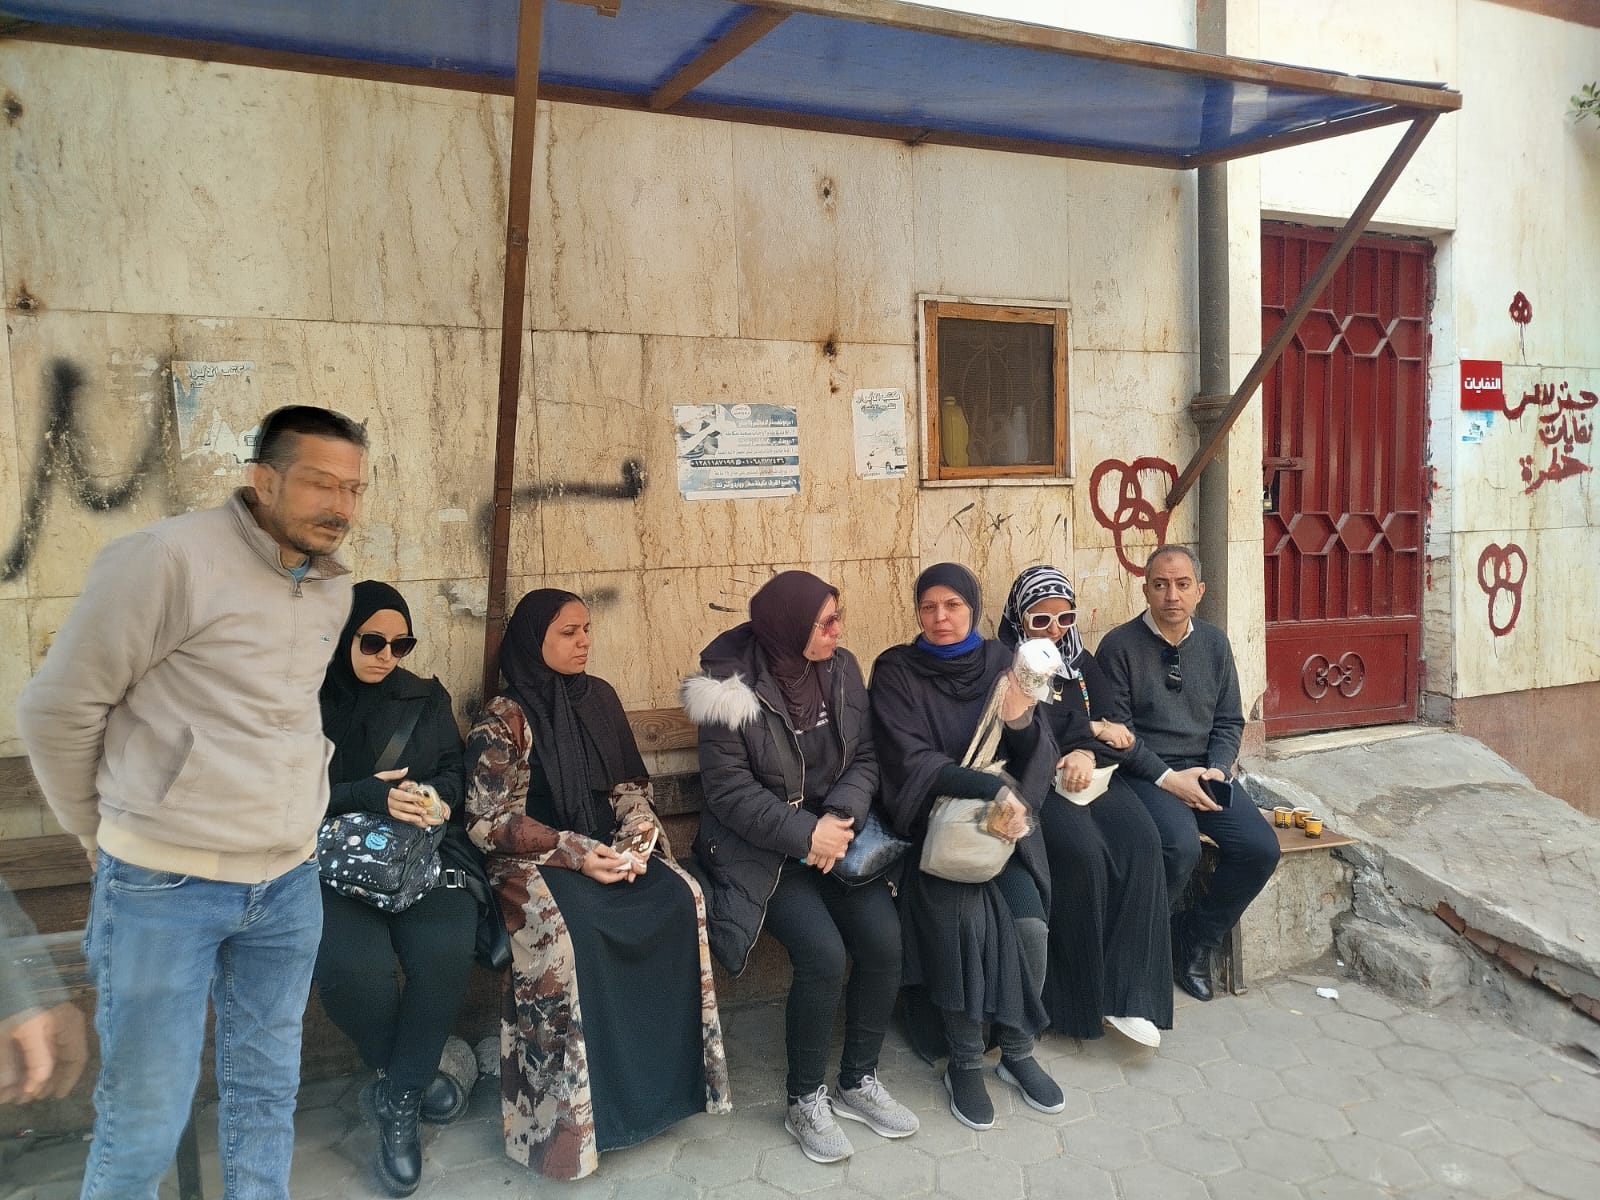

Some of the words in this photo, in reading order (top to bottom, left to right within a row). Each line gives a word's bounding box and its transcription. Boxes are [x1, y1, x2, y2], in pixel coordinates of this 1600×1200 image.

[1464, 377, 1501, 394] النفايات
[1538, 413, 1593, 454] نفايات
[1519, 447, 1593, 495] خطرة
